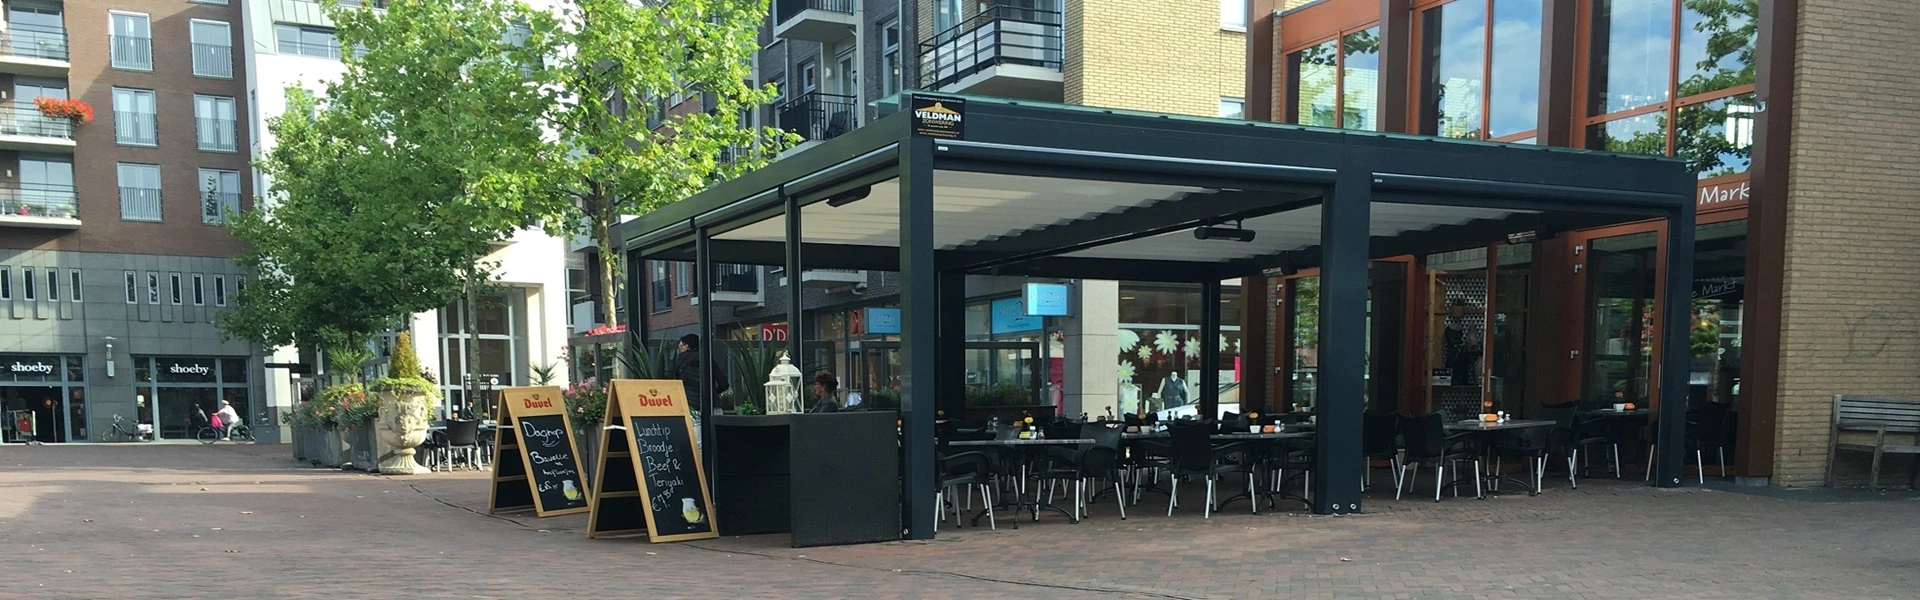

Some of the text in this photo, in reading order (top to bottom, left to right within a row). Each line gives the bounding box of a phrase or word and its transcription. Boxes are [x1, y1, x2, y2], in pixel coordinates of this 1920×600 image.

[915, 110, 962, 122] VELDMAN
[922, 119, 955, 127] ZONWERING
[1700, 182, 1750, 205] Mark
[1701, 279, 1738, 296] Markt
[11, 361, 53, 374] shoeby
[170, 363, 209, 376] shoeby
[523, 397, 553, 409] Duvel
[638, 394, 673, 407] Duvel
[634, 421, 671, 441] Lunchtip
[637, 438, 674, 458] Broodje
[646, 455, 682, 474] Beef &
[648, 472, 684, 494] Teriyaki
